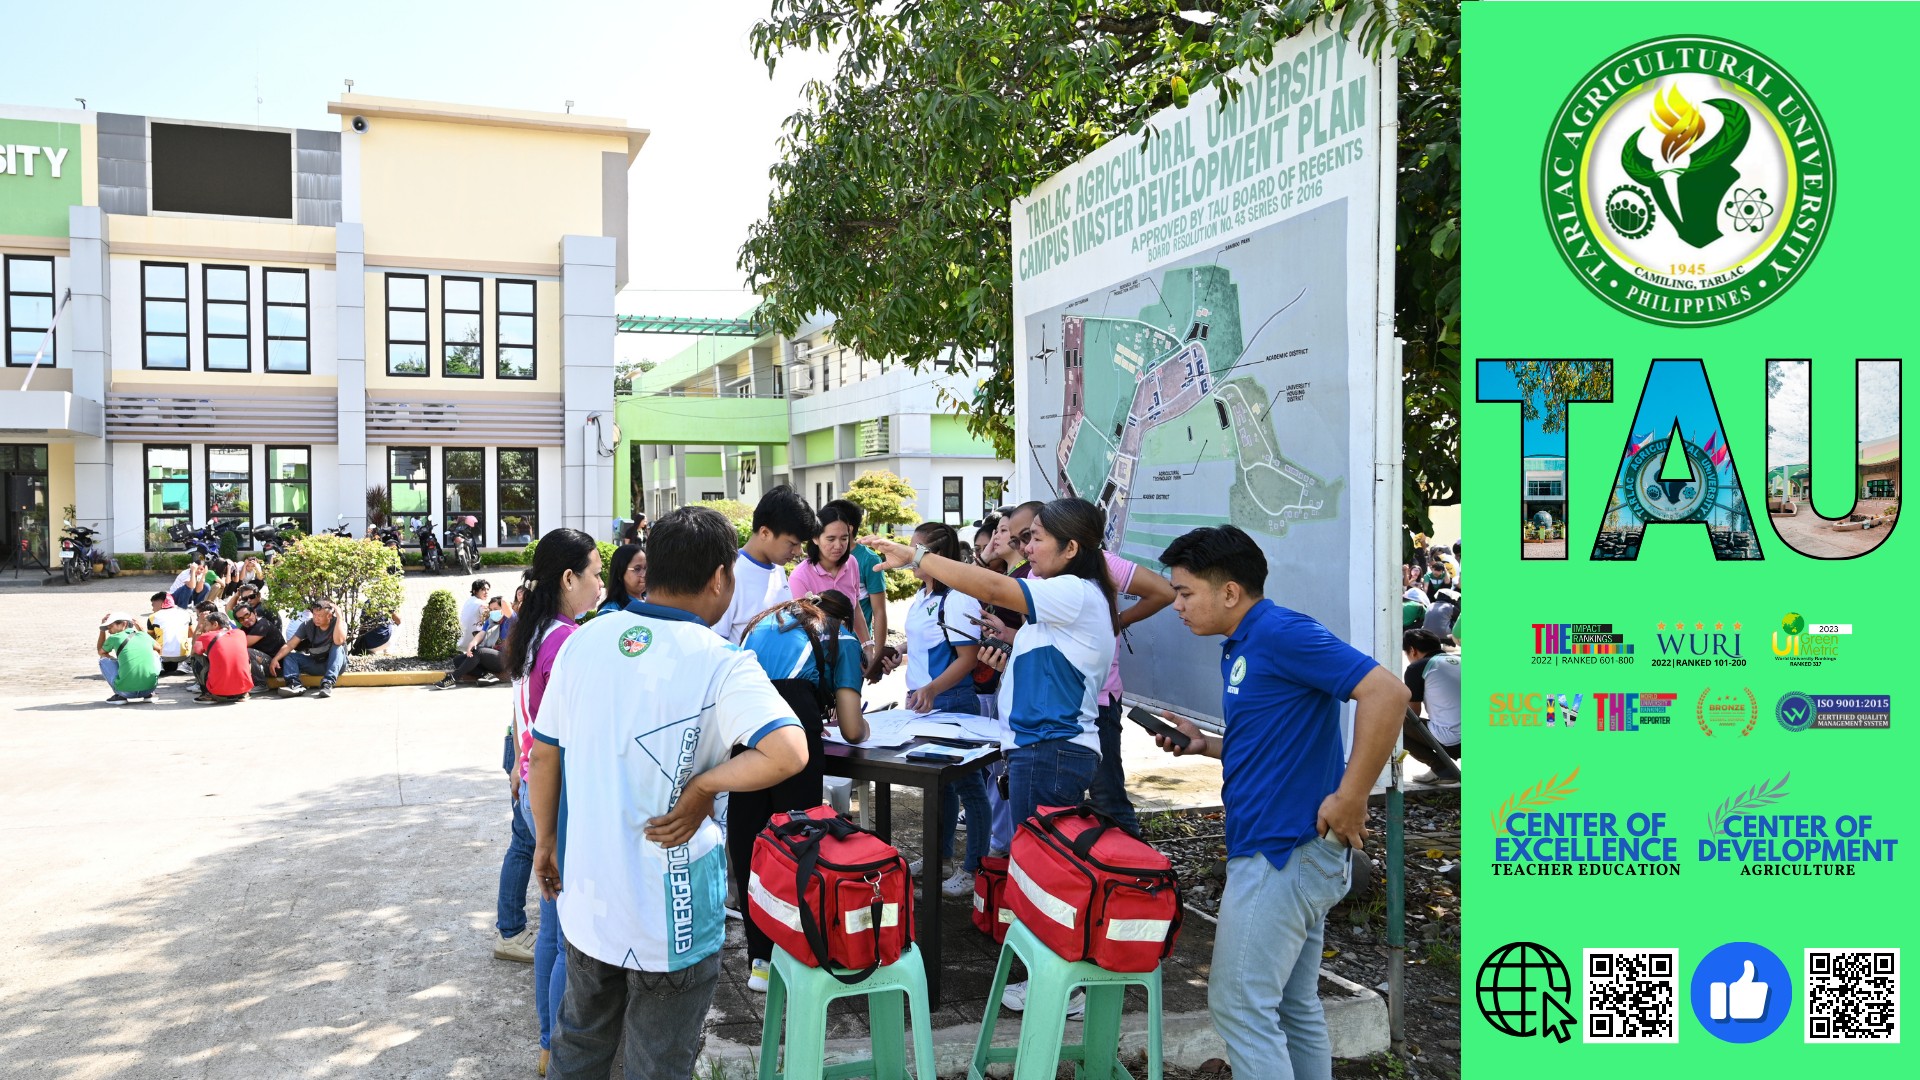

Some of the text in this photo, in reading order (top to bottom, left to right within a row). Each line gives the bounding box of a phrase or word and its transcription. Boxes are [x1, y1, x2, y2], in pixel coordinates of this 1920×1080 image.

[1019, 75, 1367, 281] CAMPUS MASTER DEVELOPMENT PLAN
[1026, 31, 1348, 240] TARLAC AGRICULTURAL UNIVERSITY
[1131, 137, 1363, 254] APPROVED BY TAU BOARD OF REGENTS
[1148, 179, 1323, 263] BOARD RESOLUTION NO. 43 SERIES OF 2016
[1289, 348, 1309, 357] DISTRICT
[667, 842, 693, 955] EMERGENC
